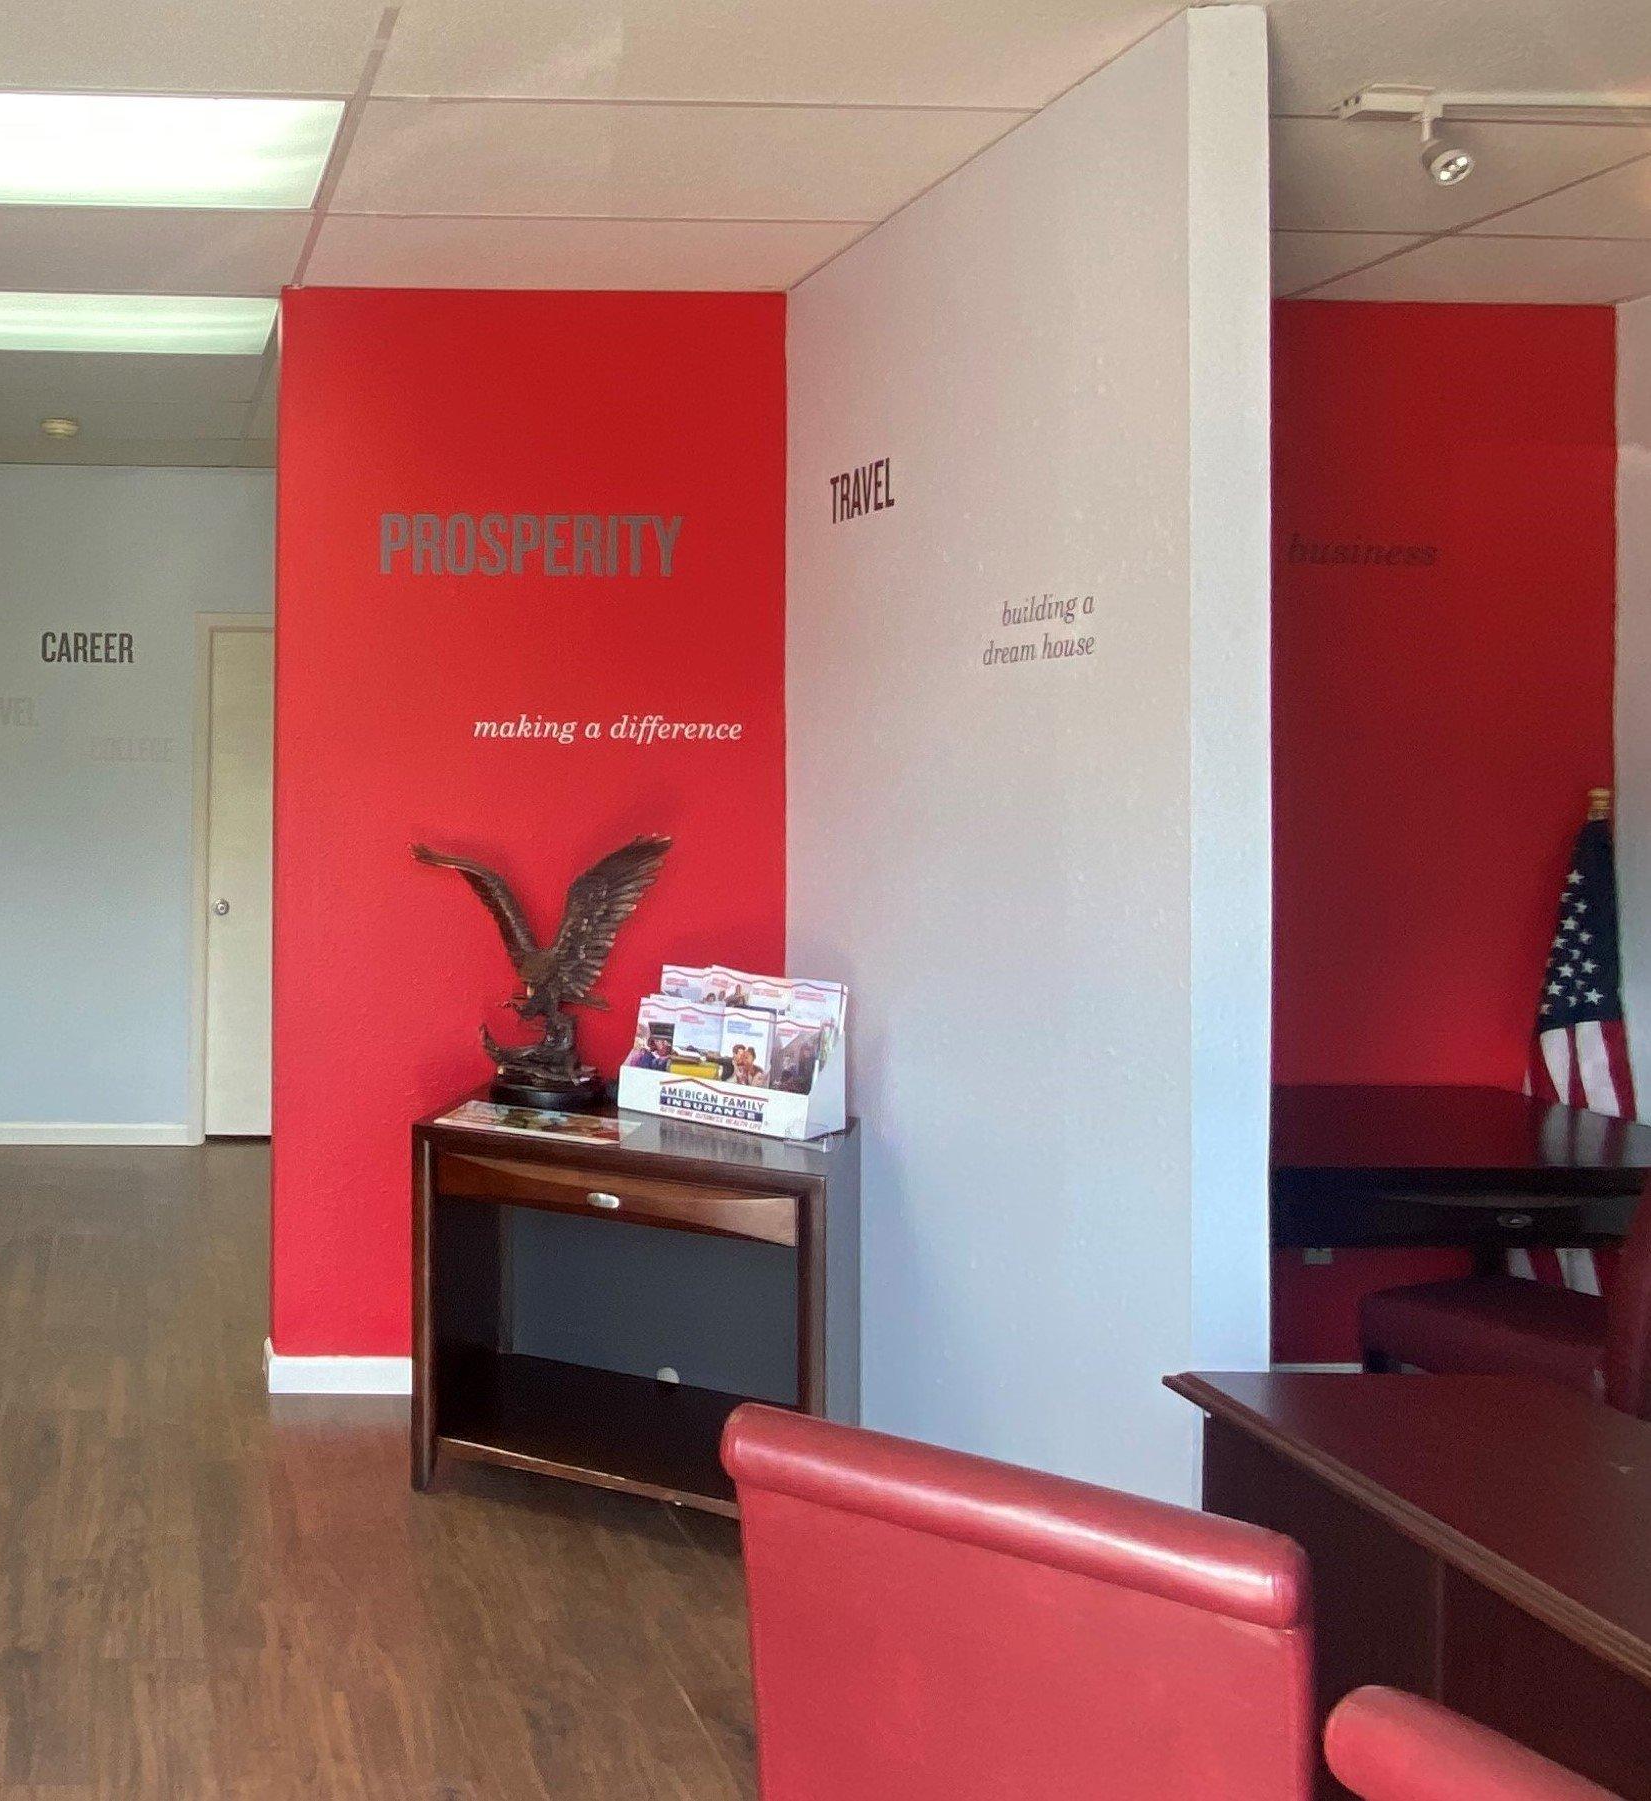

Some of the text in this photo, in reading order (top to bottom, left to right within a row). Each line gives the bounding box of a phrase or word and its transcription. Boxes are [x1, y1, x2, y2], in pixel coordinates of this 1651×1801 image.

[830, 457, 895, 524] TRAVEL
[379, 512, 683, 578] PROSPERITY
[1287, 530, 1439, 566] business
[1002, 593, 1095, 627] building a
[41, 631, 135, 664] CAREER
[982, 633, 1095, 666] dream house
[473, 714, 743, 745] making a difference
[660, 1086, 765, 1112] AMERICAN FAMILY
[666, 1097, 756, 1120] INSURANCE
